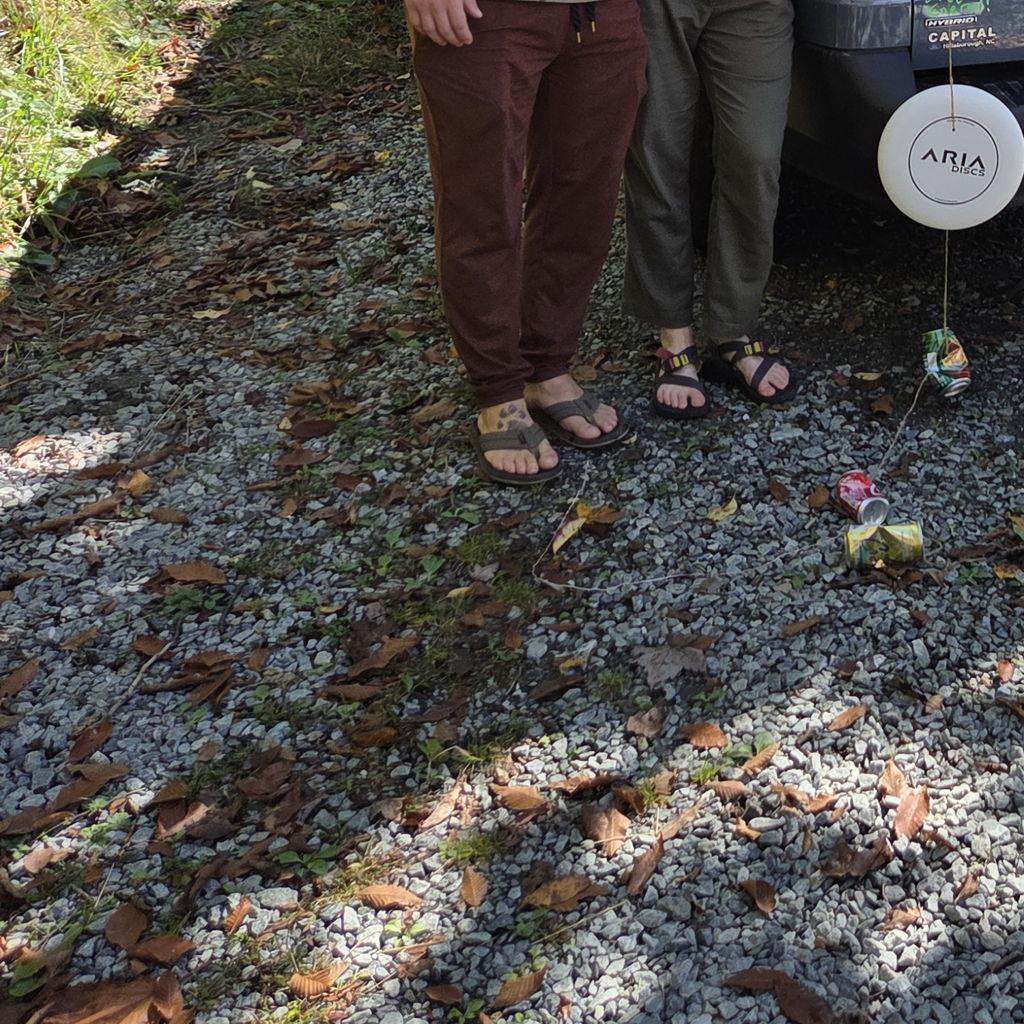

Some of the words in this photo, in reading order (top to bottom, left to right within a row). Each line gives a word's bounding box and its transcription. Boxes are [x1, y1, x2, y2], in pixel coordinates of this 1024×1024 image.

[928, 17, 975, 27] HYBRID
[928, 26, 996, 44] CAPITAL
[920, 147, 986, 170] ARIA
[951, 165, 986, 177] DISCS
